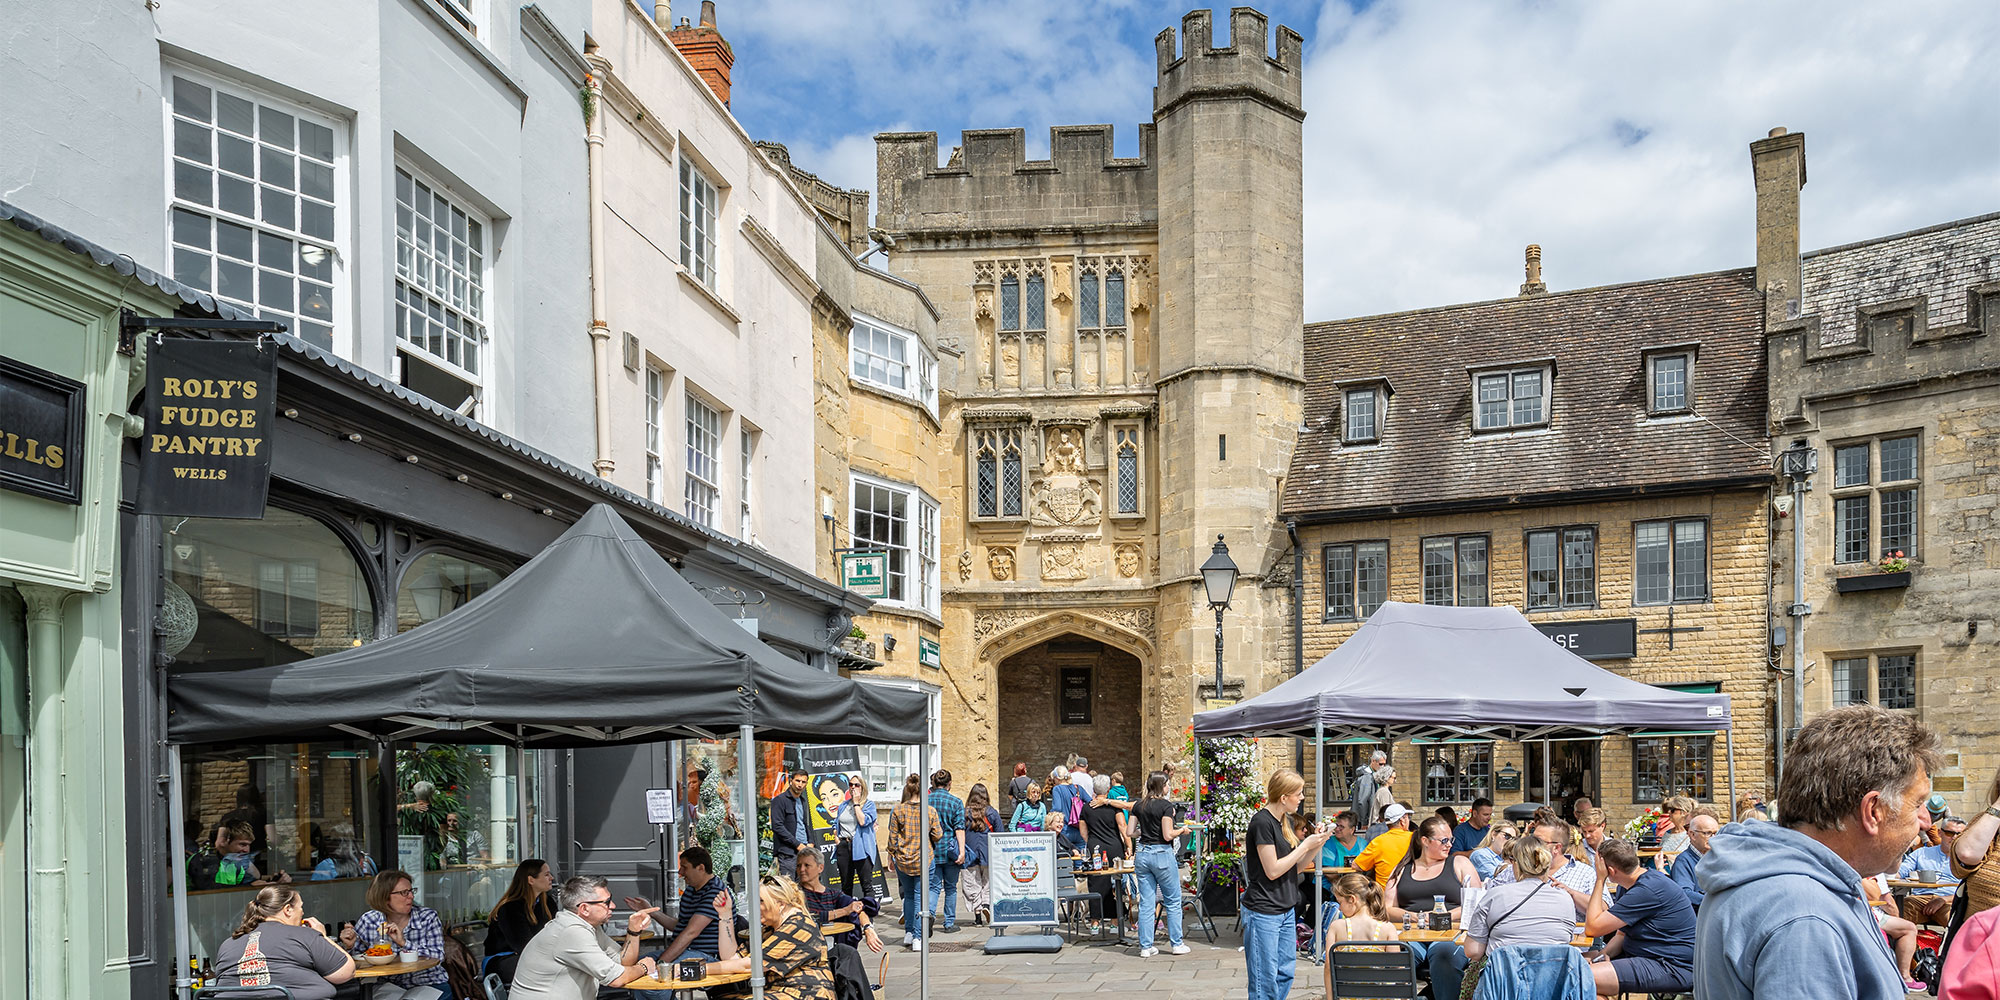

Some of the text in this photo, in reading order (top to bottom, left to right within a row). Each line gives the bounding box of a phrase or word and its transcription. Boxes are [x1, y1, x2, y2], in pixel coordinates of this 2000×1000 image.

[163, 377, 258, 400] ROLY'S
[161, 406, 256, 428] FUDGE
[150, 434, 262, 456] PANTRY
[173, 467, 227, 480] WELLS
[1550, 633, 1579, 649] SE
[994, 838, 1052, 846] Runway Boutique
[682, 968, 694, 978] 54
